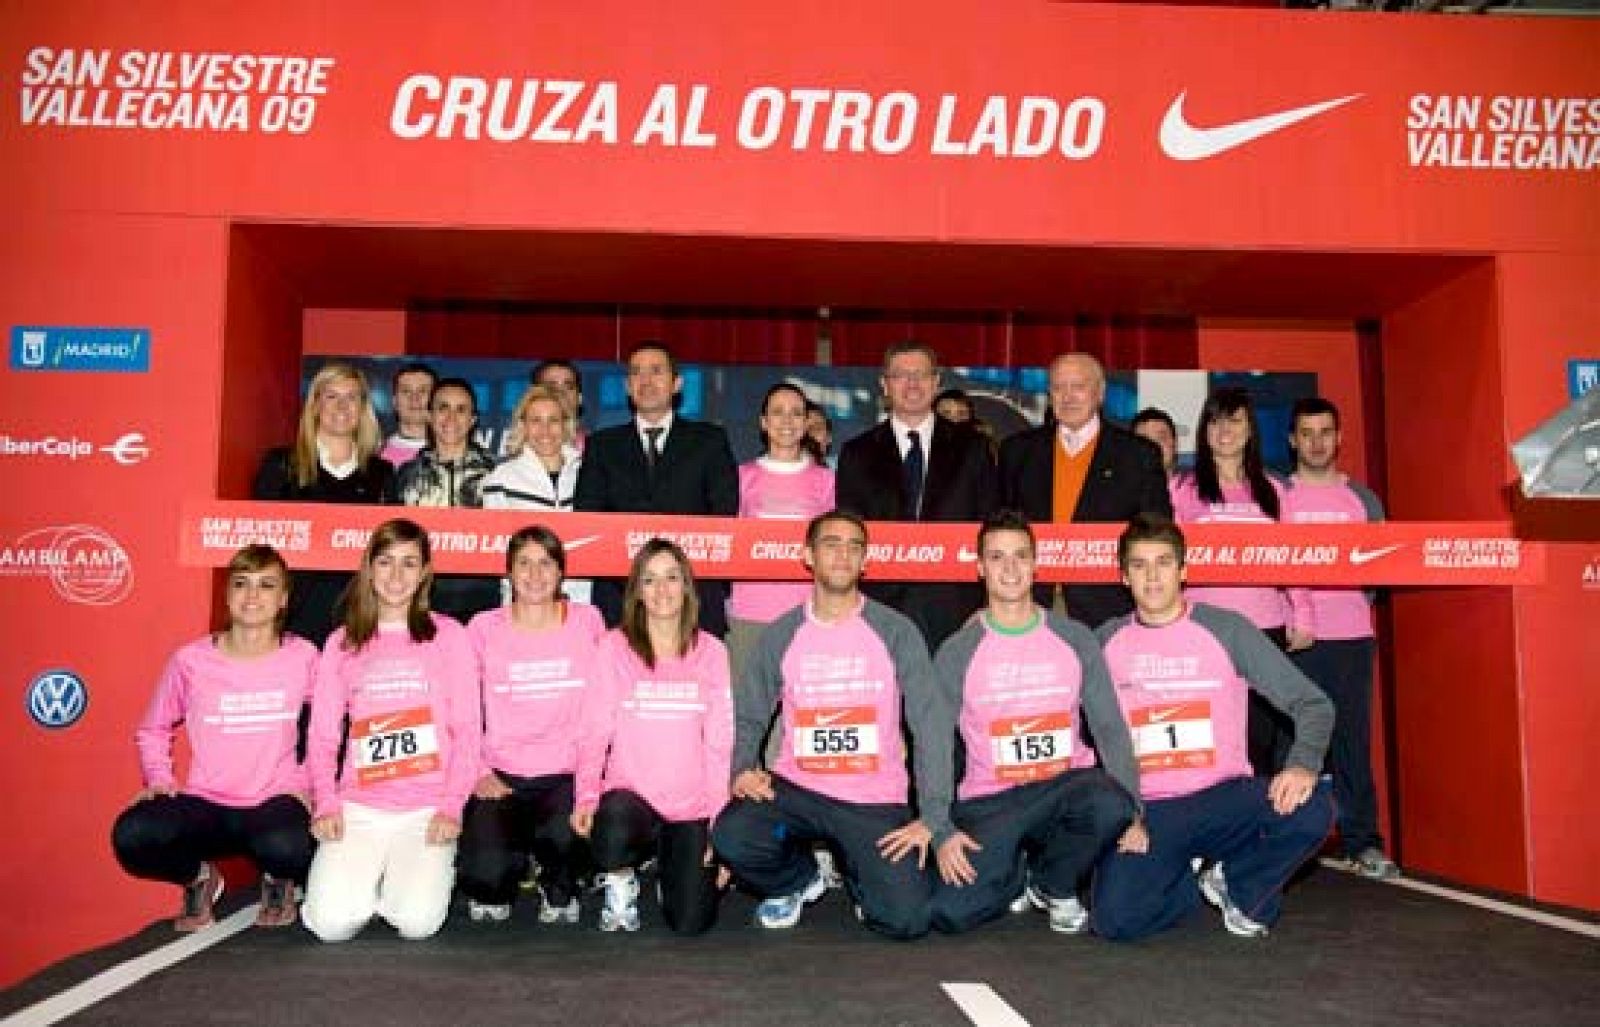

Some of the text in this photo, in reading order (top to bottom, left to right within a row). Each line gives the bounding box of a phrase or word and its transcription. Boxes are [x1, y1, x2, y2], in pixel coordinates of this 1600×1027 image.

[22, 47, 335, 95] SAN SILVESTRE
[20, 89, 317, 134] VALLECANA 09
[390, 74, 1106, 161] CRUZA AL OTRO LADO
[1407, 93, 1600, 135] SAN SILVES
[202, 517, 312, 535] SAN SILVESTRE
[332, 529, 373, 548] CRU
[480, 534, 513, 553] LA
[752, 543, 804, 560] CRUZ
[895, 544, 944, 562] LADO
[1424, 538, 1522, 553] SAN SILVESTRE
[1216, 546, 1237, 565] AL
[1242, 546, 1290, 566] OTRO
[1291, 546, 1339, 565] LADO
[1424, 554, 1499, 568] VALLECANA
[369, 731, 417, 763] 278
[813, 727, 859, 754] 555
[1009, 734, 1055, 762] 153
[1165, 724, 1176, 748] 1
